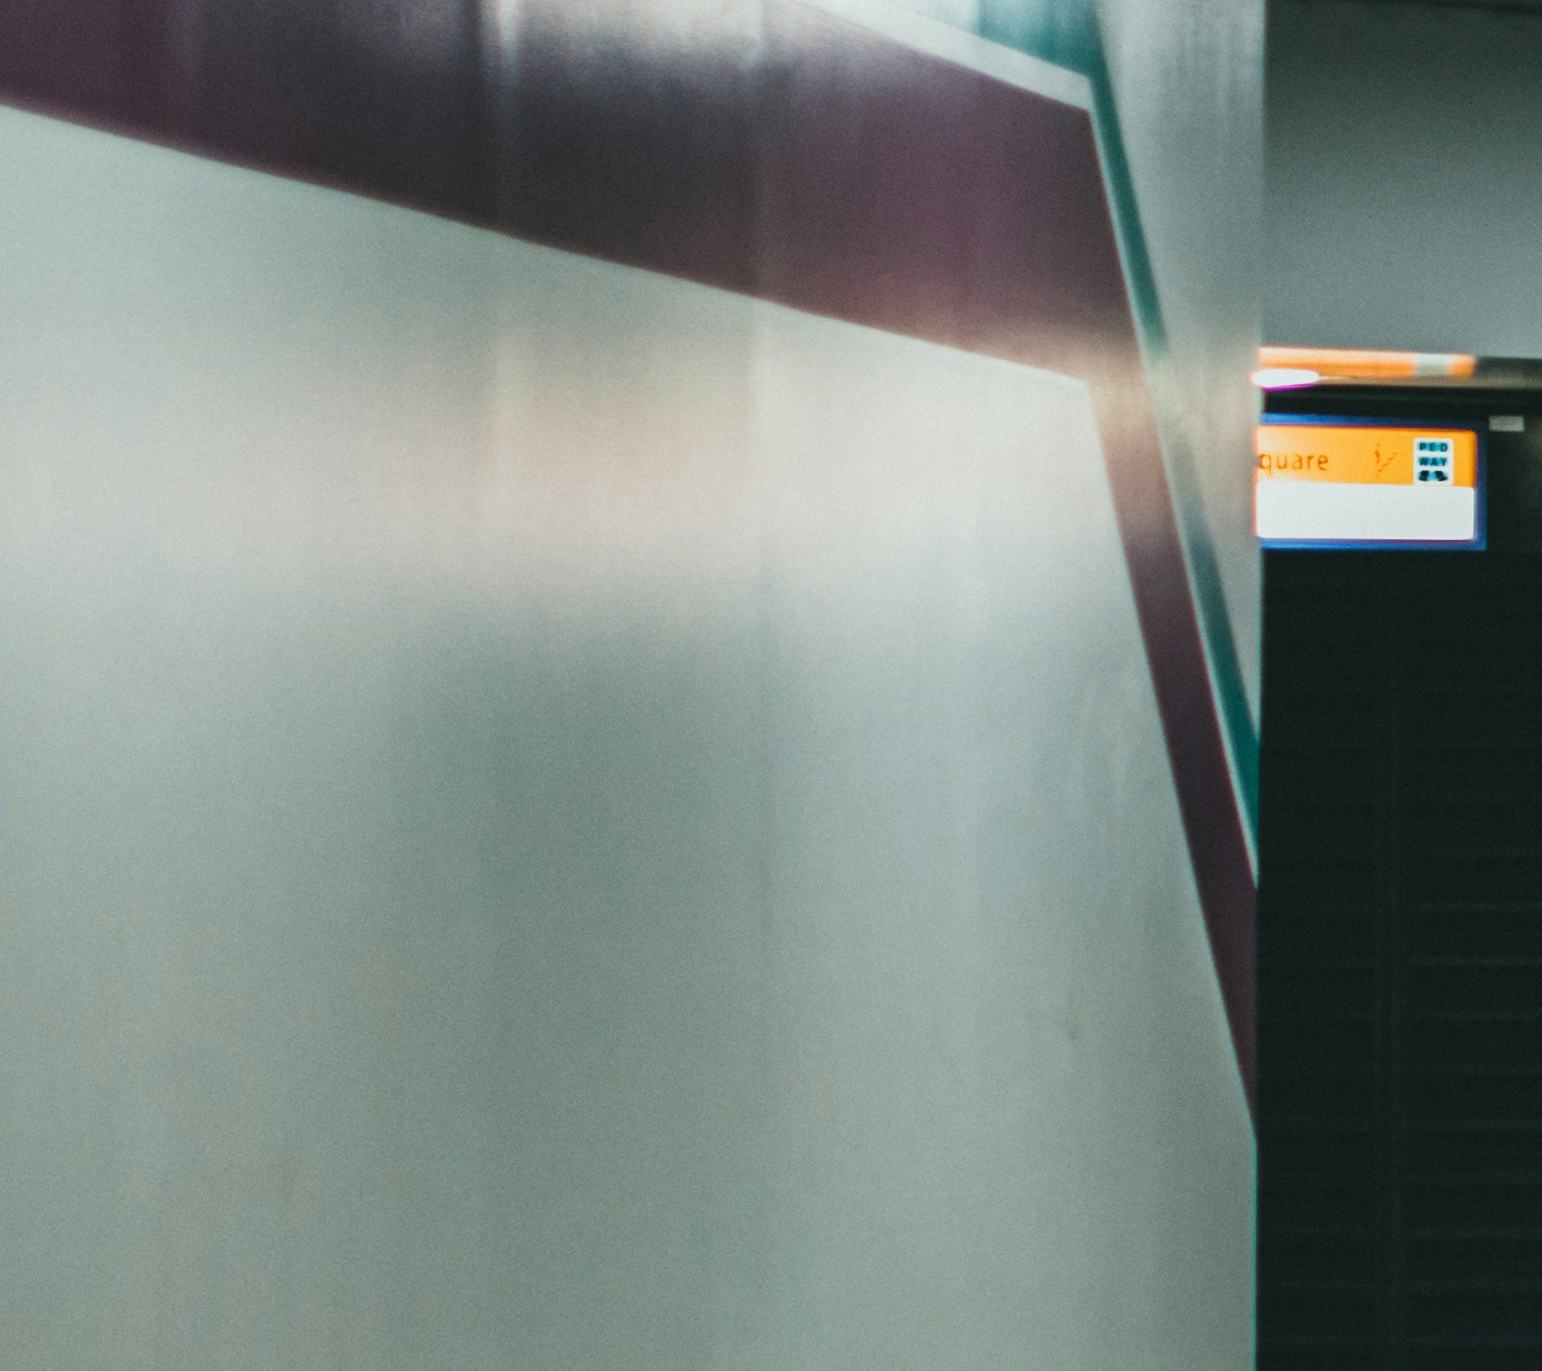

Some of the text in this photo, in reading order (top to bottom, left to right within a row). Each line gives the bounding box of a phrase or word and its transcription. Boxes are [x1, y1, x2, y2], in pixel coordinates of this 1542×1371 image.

[1418, 441, 1449, 452] PED
[1258, 453, 1329, 477] quare
[1418, 456, 1448, 466] WAY
